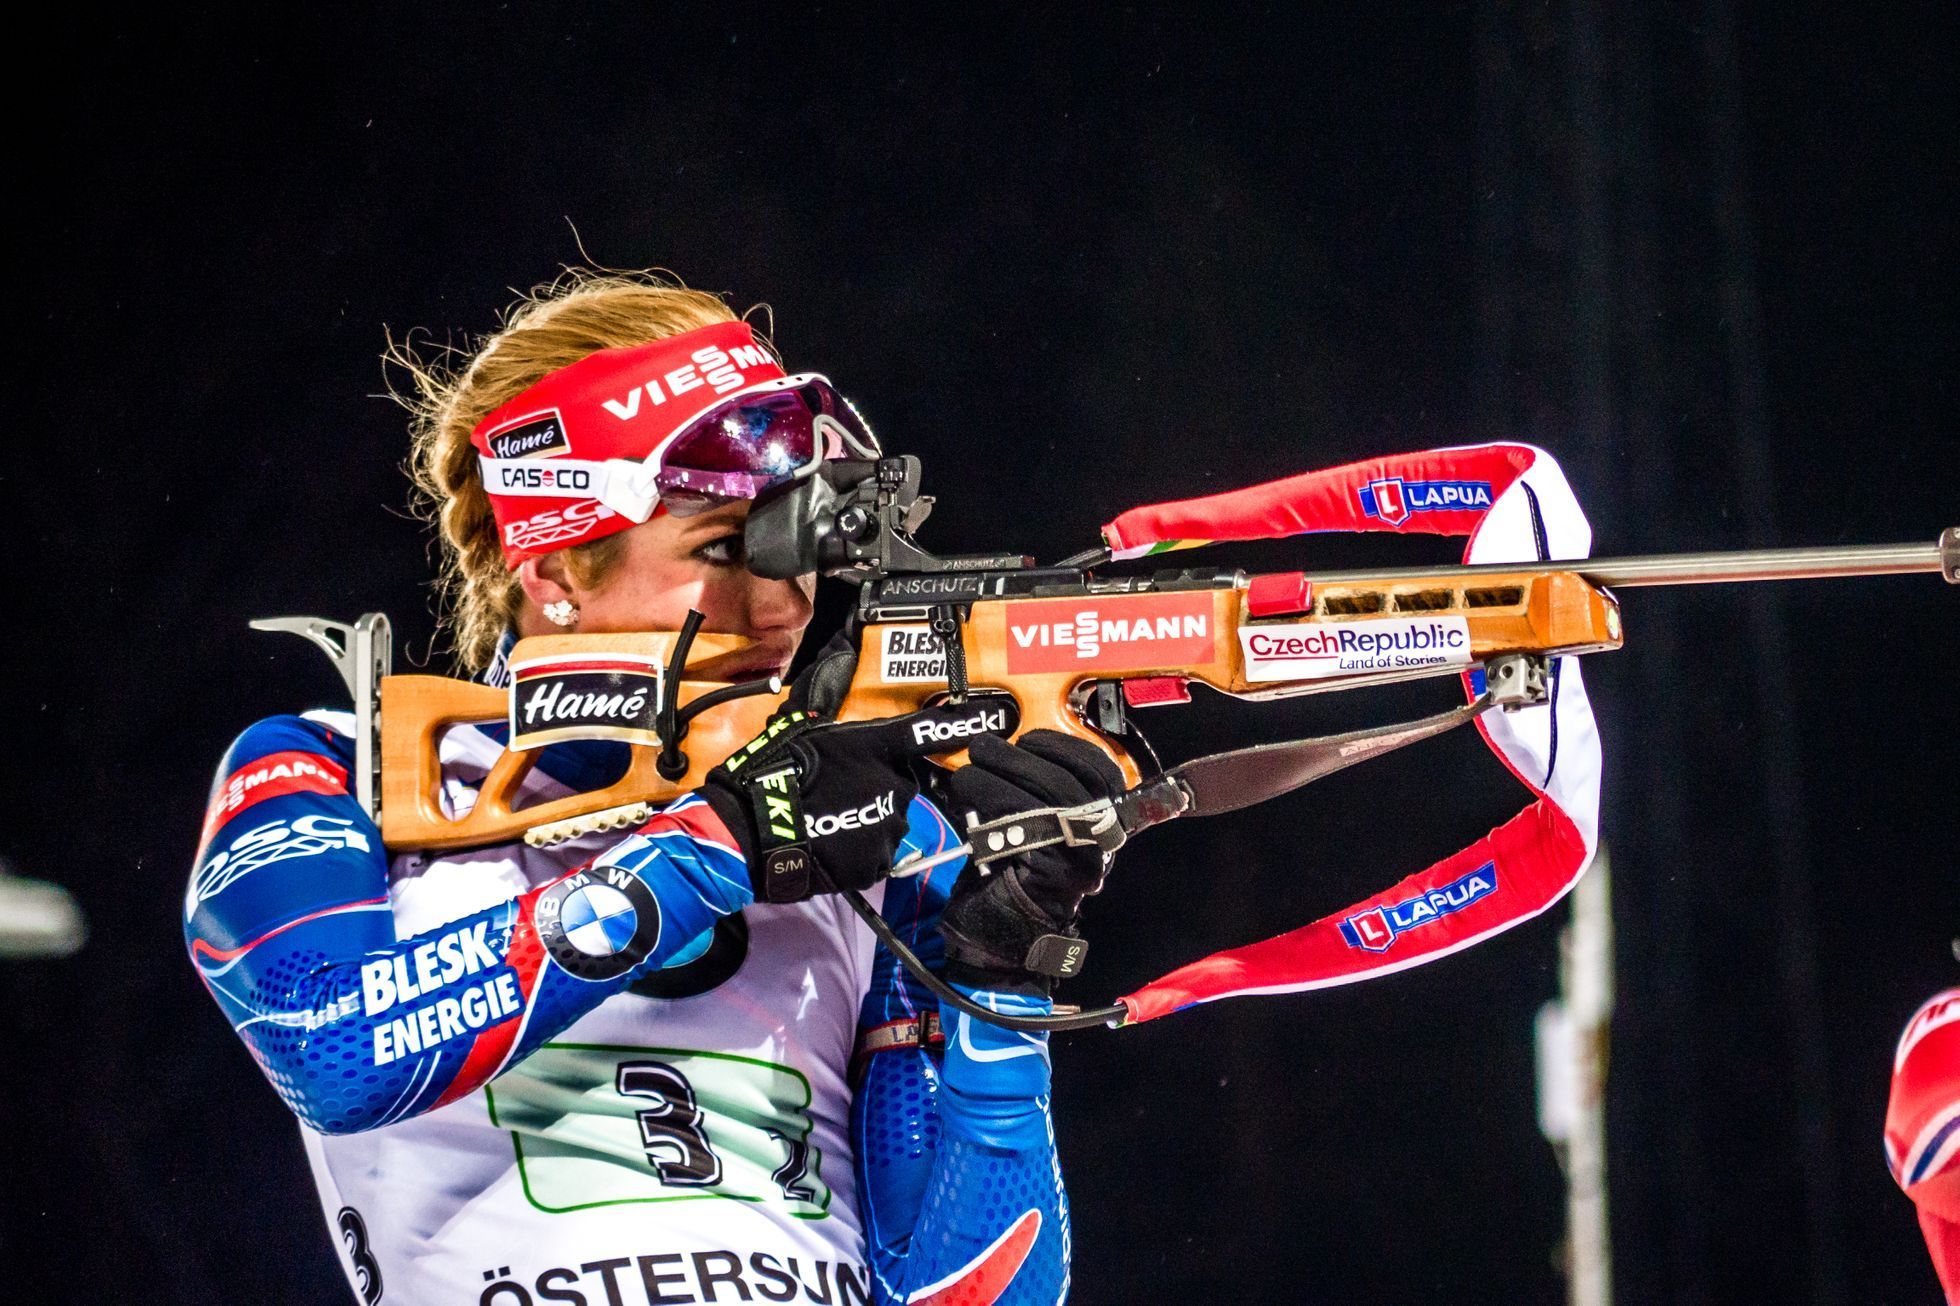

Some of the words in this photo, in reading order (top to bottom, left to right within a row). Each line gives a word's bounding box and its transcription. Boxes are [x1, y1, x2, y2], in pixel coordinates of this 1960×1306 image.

[497, 425, 554, 458] Hamé
[1408, 486, 1490, 505] LAPUA
[1011, 611, 1206, 658] VIESSMANN
[887, 660, 948, 677] ENERGI
[1339, 656, 1374, 669] Land
[1377, 655, 1391, 668] of
[1395, 654, 1447, 667] Stories
[525, 682, 648, 724] Hamé
[757, 768, 796, 840] EKI
[774, 859, 803, 874] S/M
[539, 868, 634, 917] BMW
[1394, 876, 1491, 927] LAPUA
[361, 920, 499, 1018] BLESK
[1060, 946, 1080, 972] S/M
[373, 973, 520, 1067] ENERGIE
[616, 1060, 723, 1187] 3
[479, 1250, 873, 1306] ÖSTERSUN
